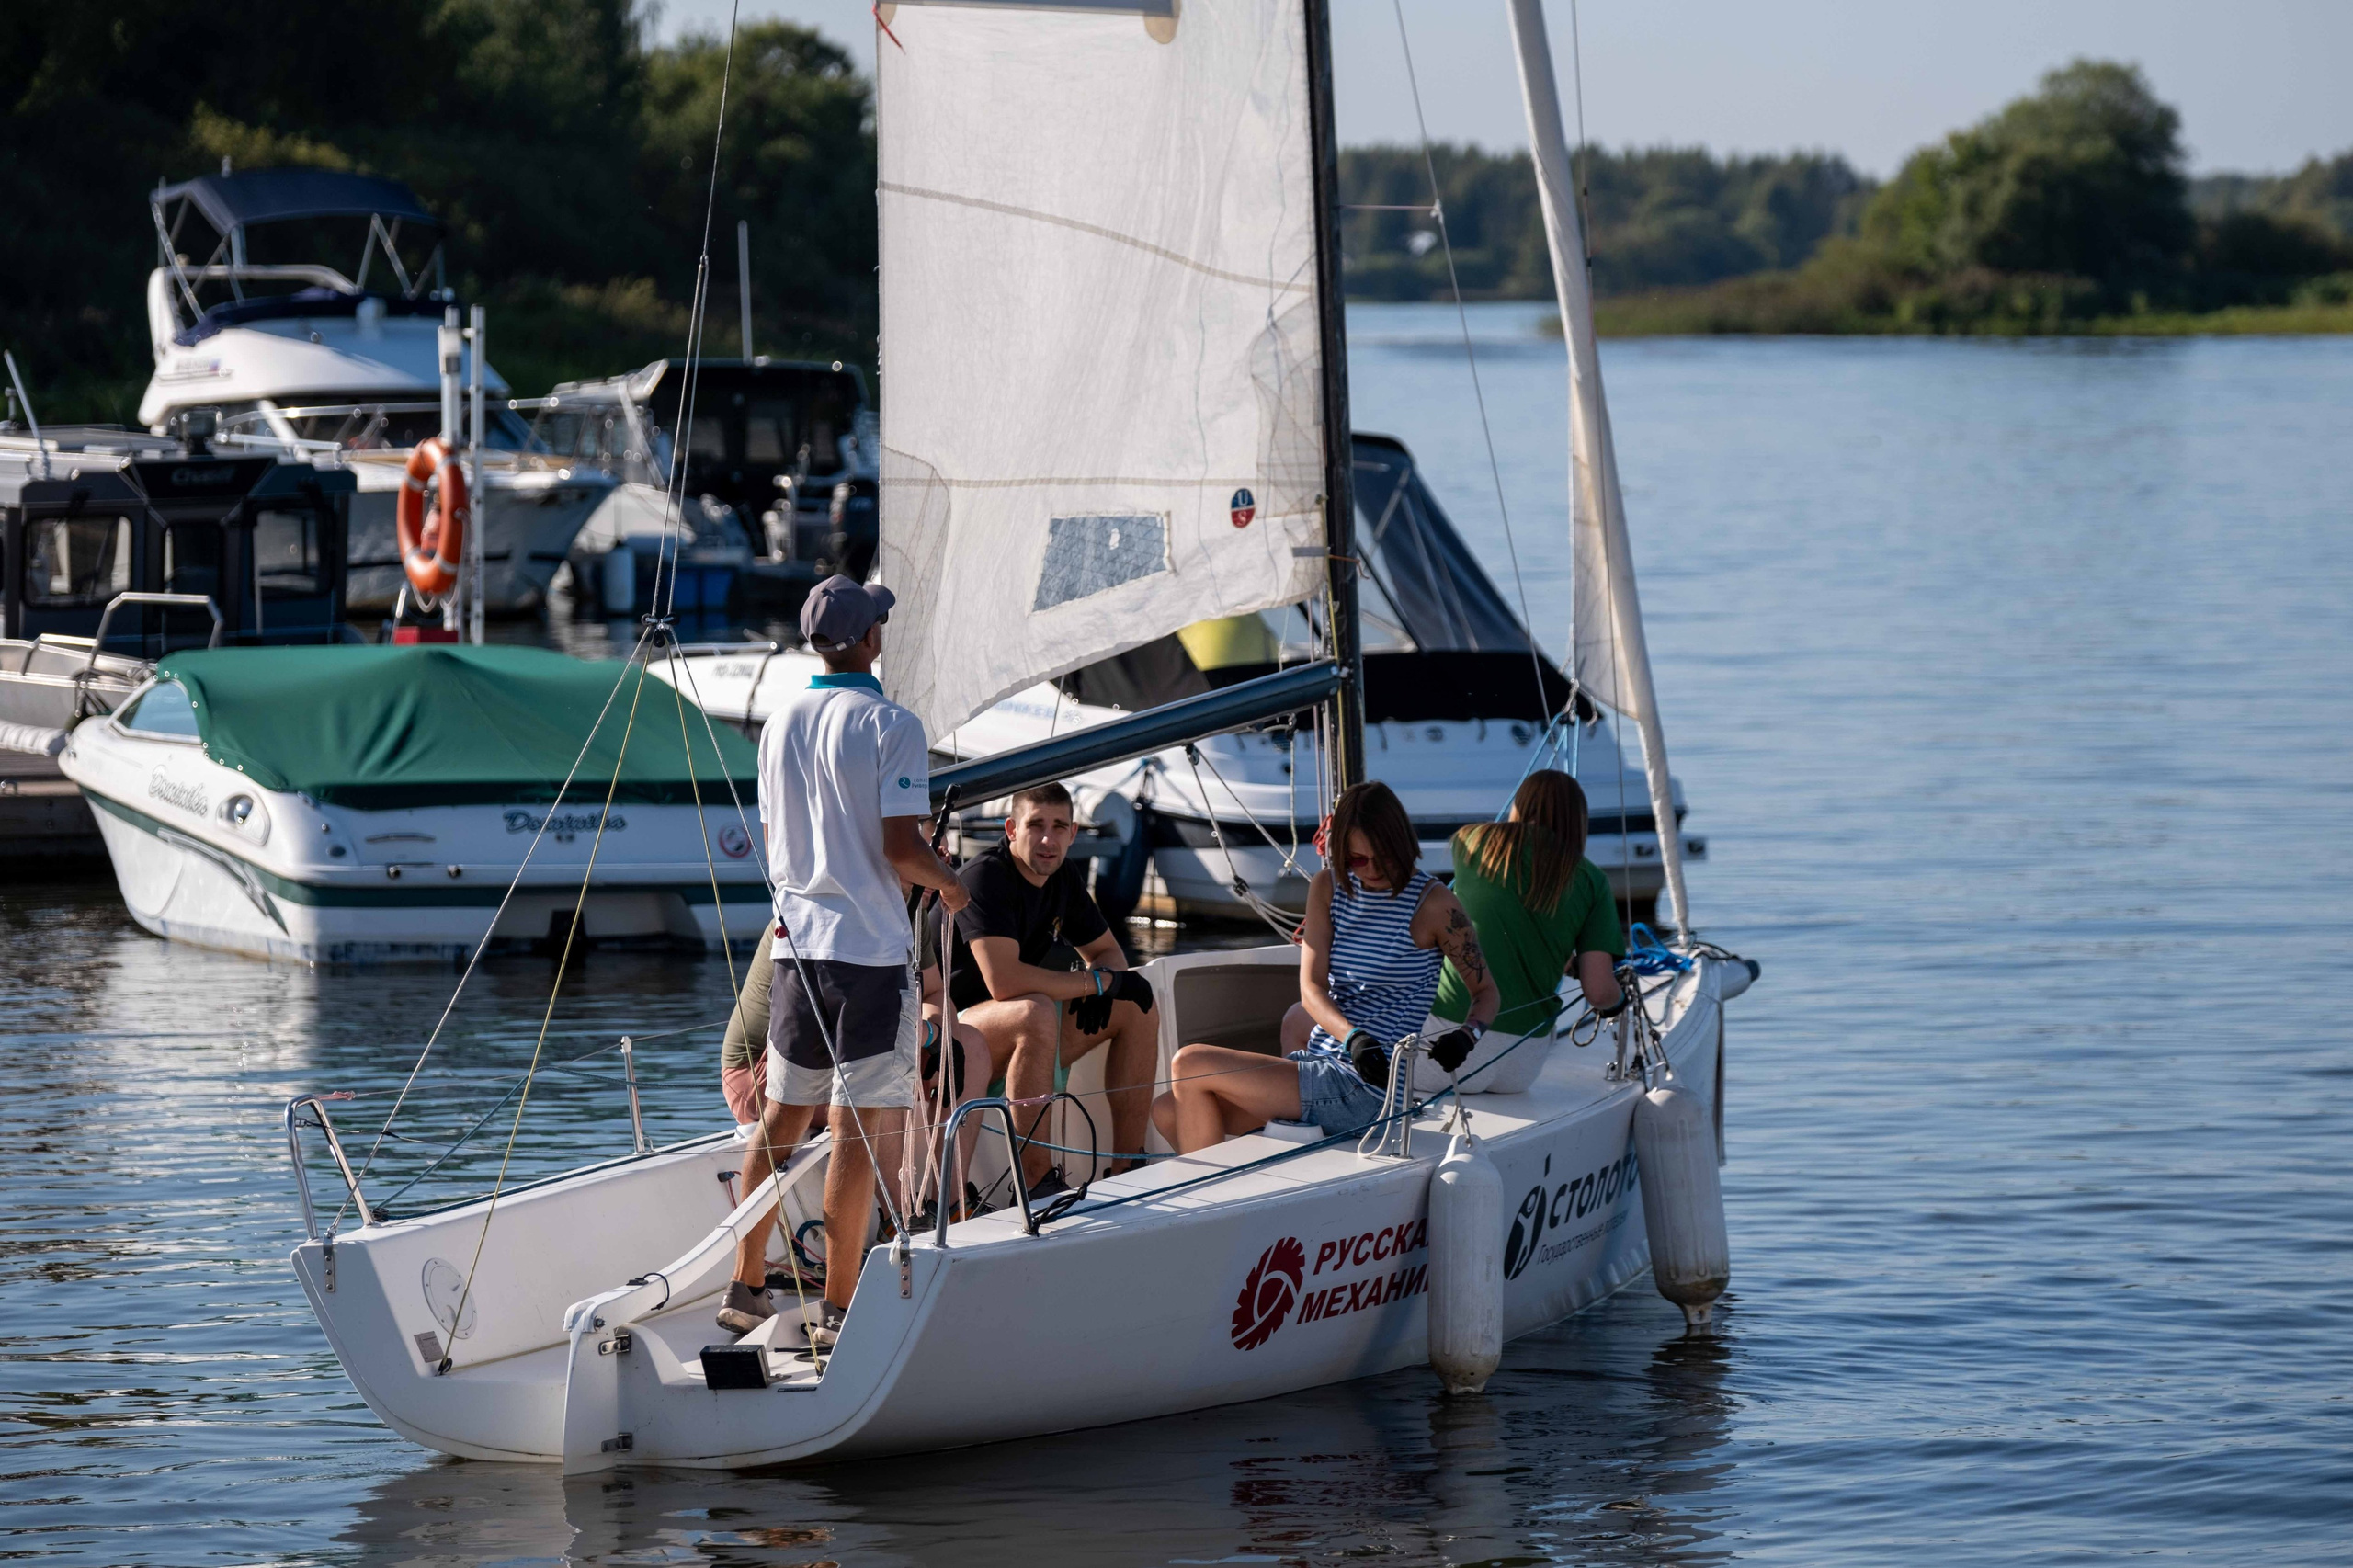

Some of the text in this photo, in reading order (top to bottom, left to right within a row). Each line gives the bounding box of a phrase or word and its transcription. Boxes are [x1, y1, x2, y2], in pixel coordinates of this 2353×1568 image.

[1237, 490, 1249, 506] U
[1313, 1218, 1428, 1276] РУССКА
[1296, 1263, 1428, 1324] МЕХАНИ
